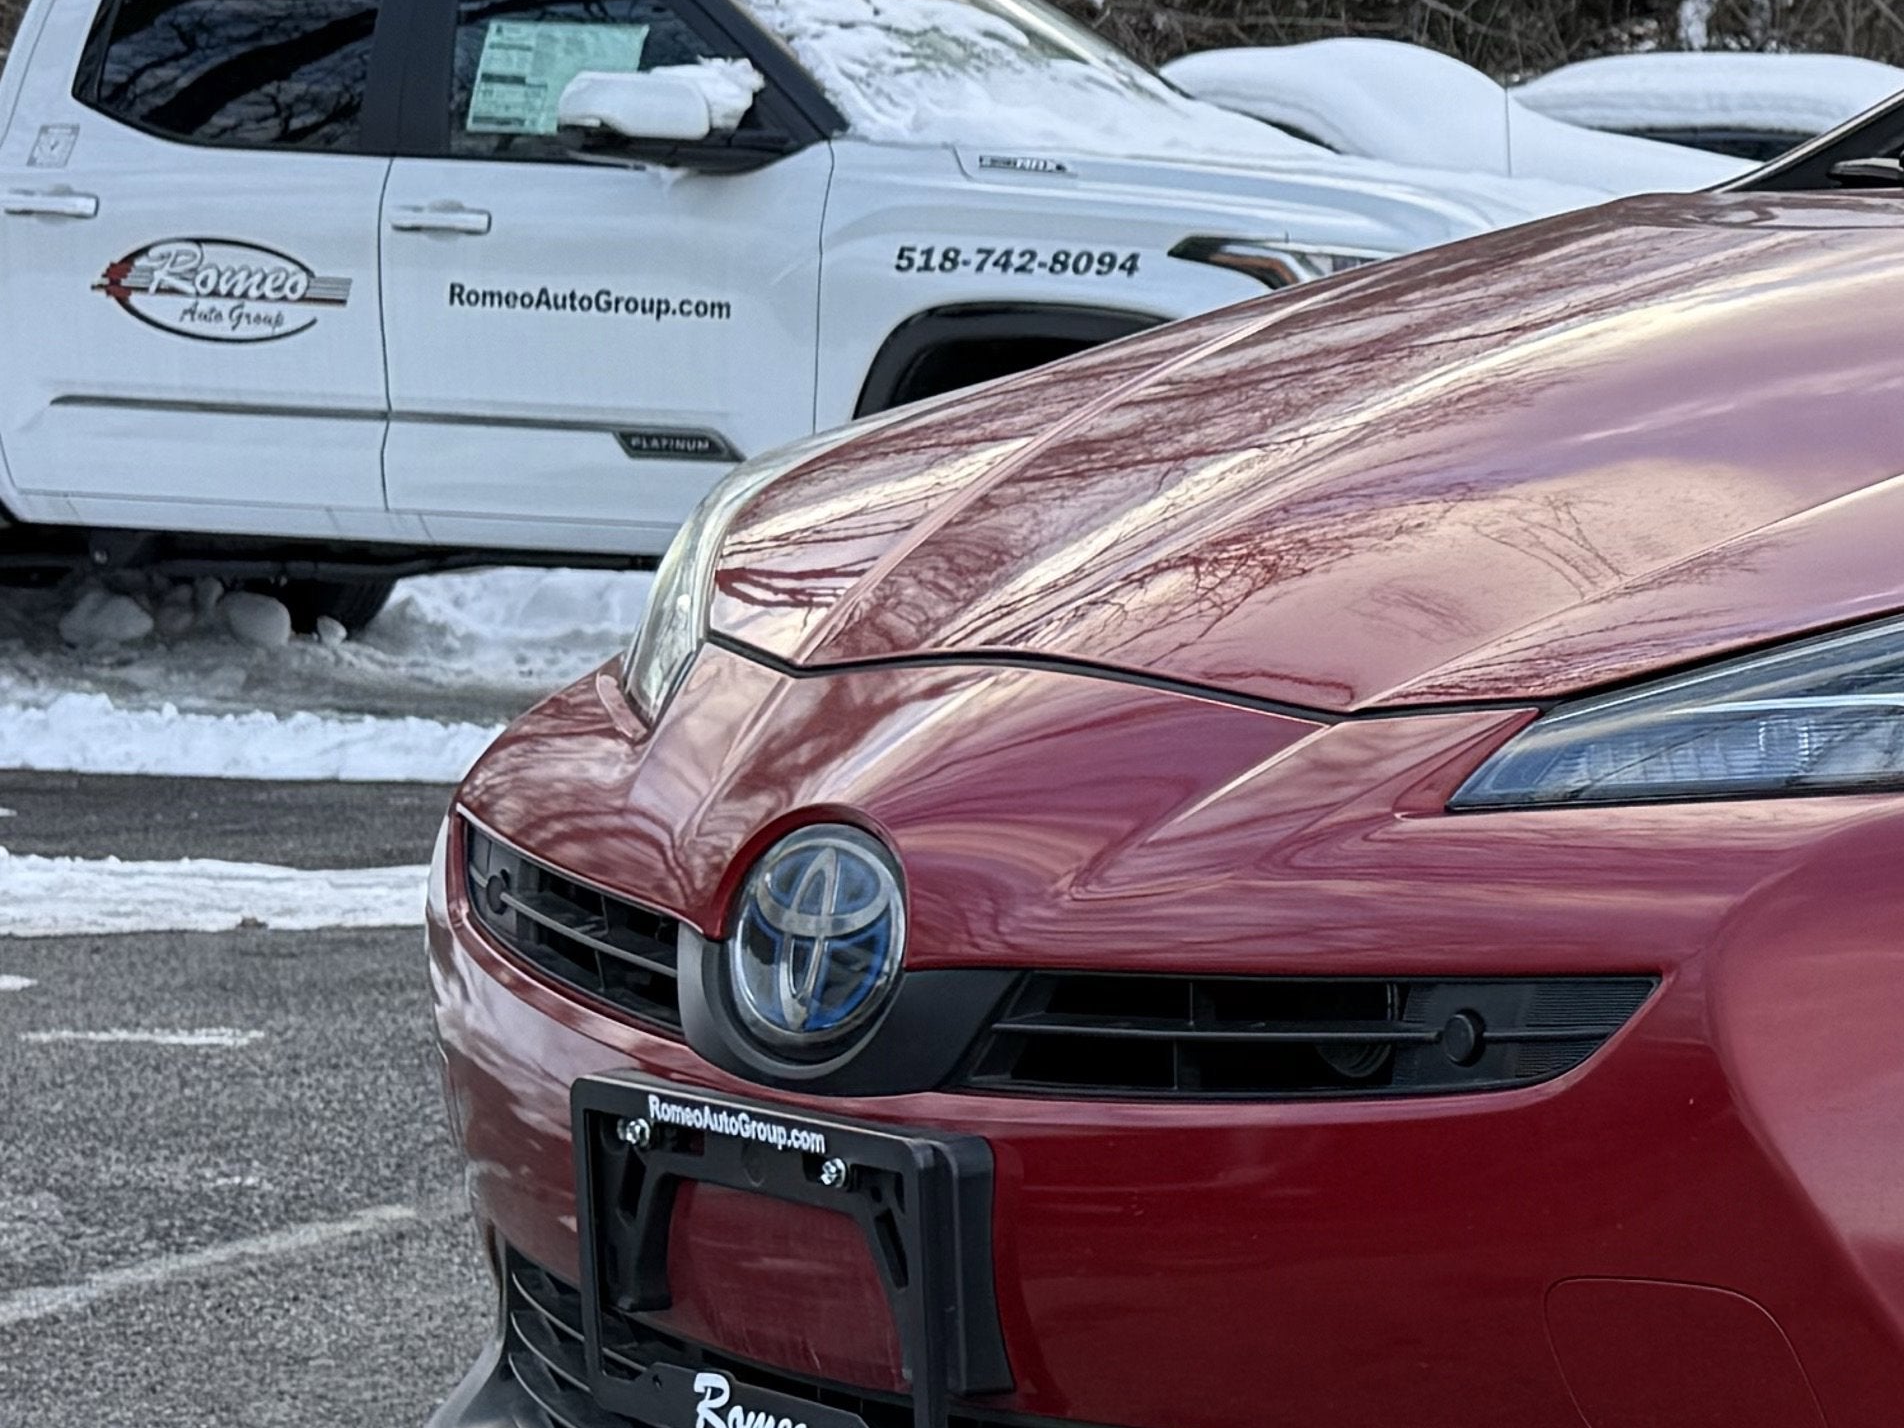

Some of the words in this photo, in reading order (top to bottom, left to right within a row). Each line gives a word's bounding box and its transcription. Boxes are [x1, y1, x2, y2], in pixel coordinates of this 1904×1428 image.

[147, 242, 308, 302] Romeo
[894, 246, 1141, 276] 518-742-8094
[179, 301, 224, 323] Auto
[228, 302, 285, 333] Group
[449, 282, 731, 321] RomeoAutoGroup.com
[631, 436, 710, 452] PLATINUM
[648, 1094, 826, 1154] RomeoAutoGroup.com
